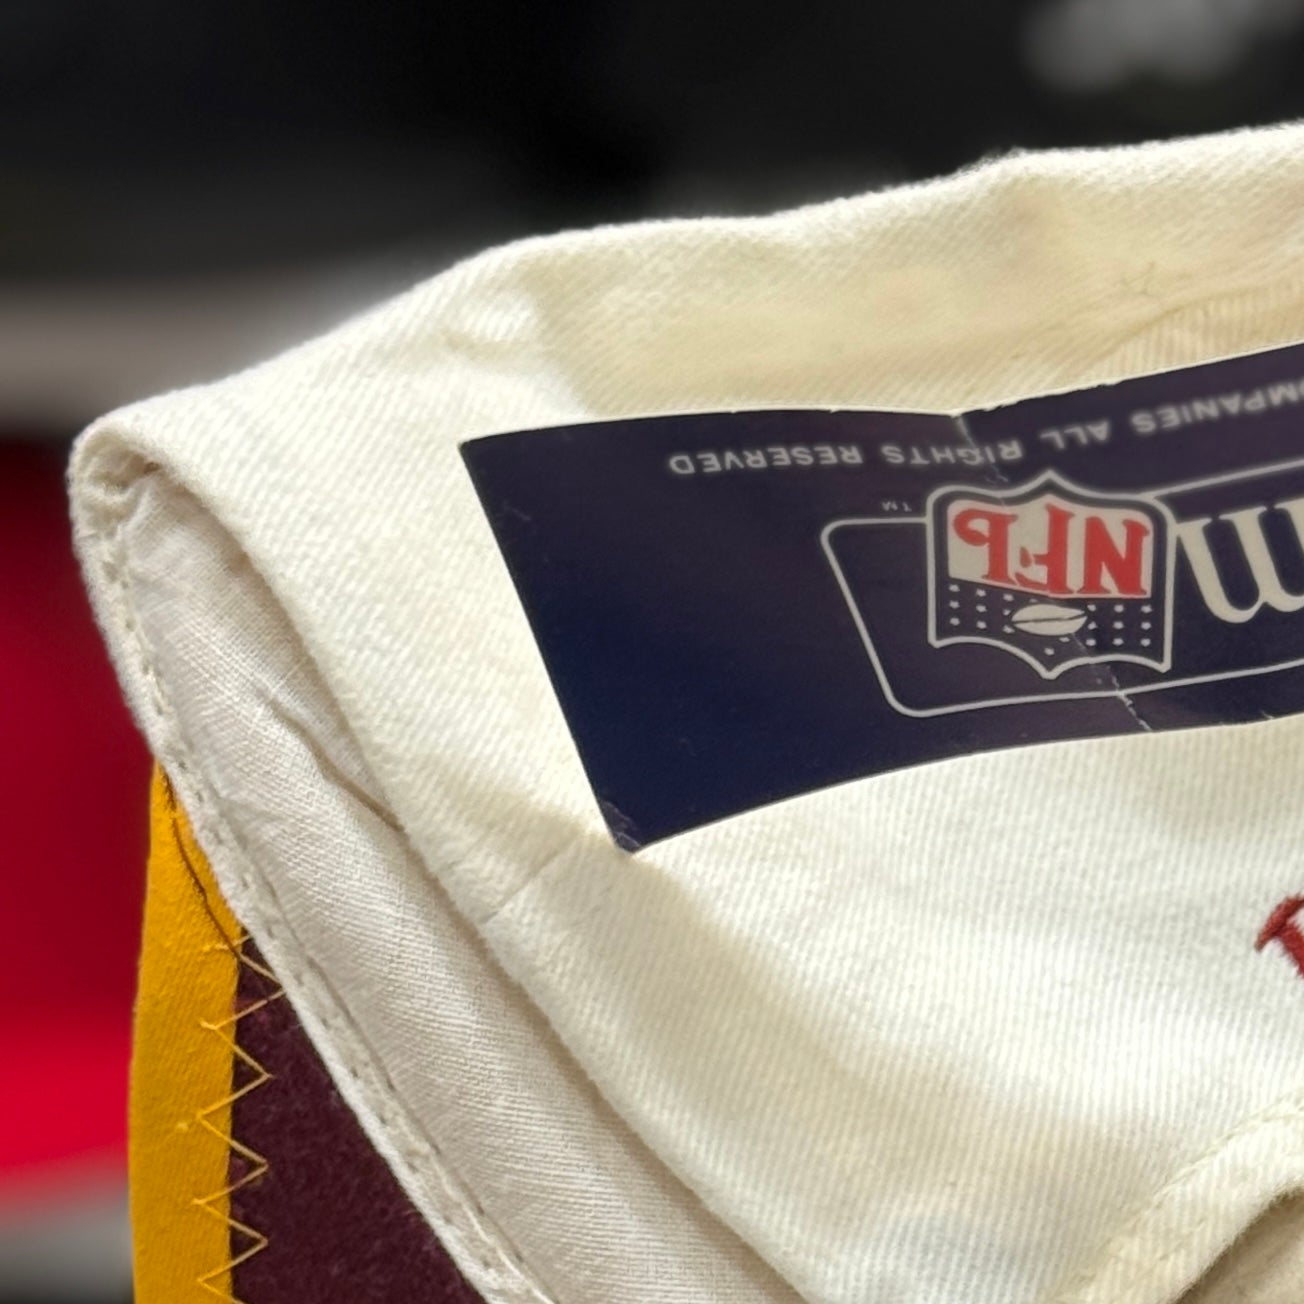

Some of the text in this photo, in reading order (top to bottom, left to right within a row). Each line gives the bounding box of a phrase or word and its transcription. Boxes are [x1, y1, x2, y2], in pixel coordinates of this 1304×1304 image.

[1041, 420, 1111, 450] ALL
[669, 443, 863, 476] RESERVED
[883, 439, 1023, 467] RIGHTS
[952, 503, 1151, 598] NFL
